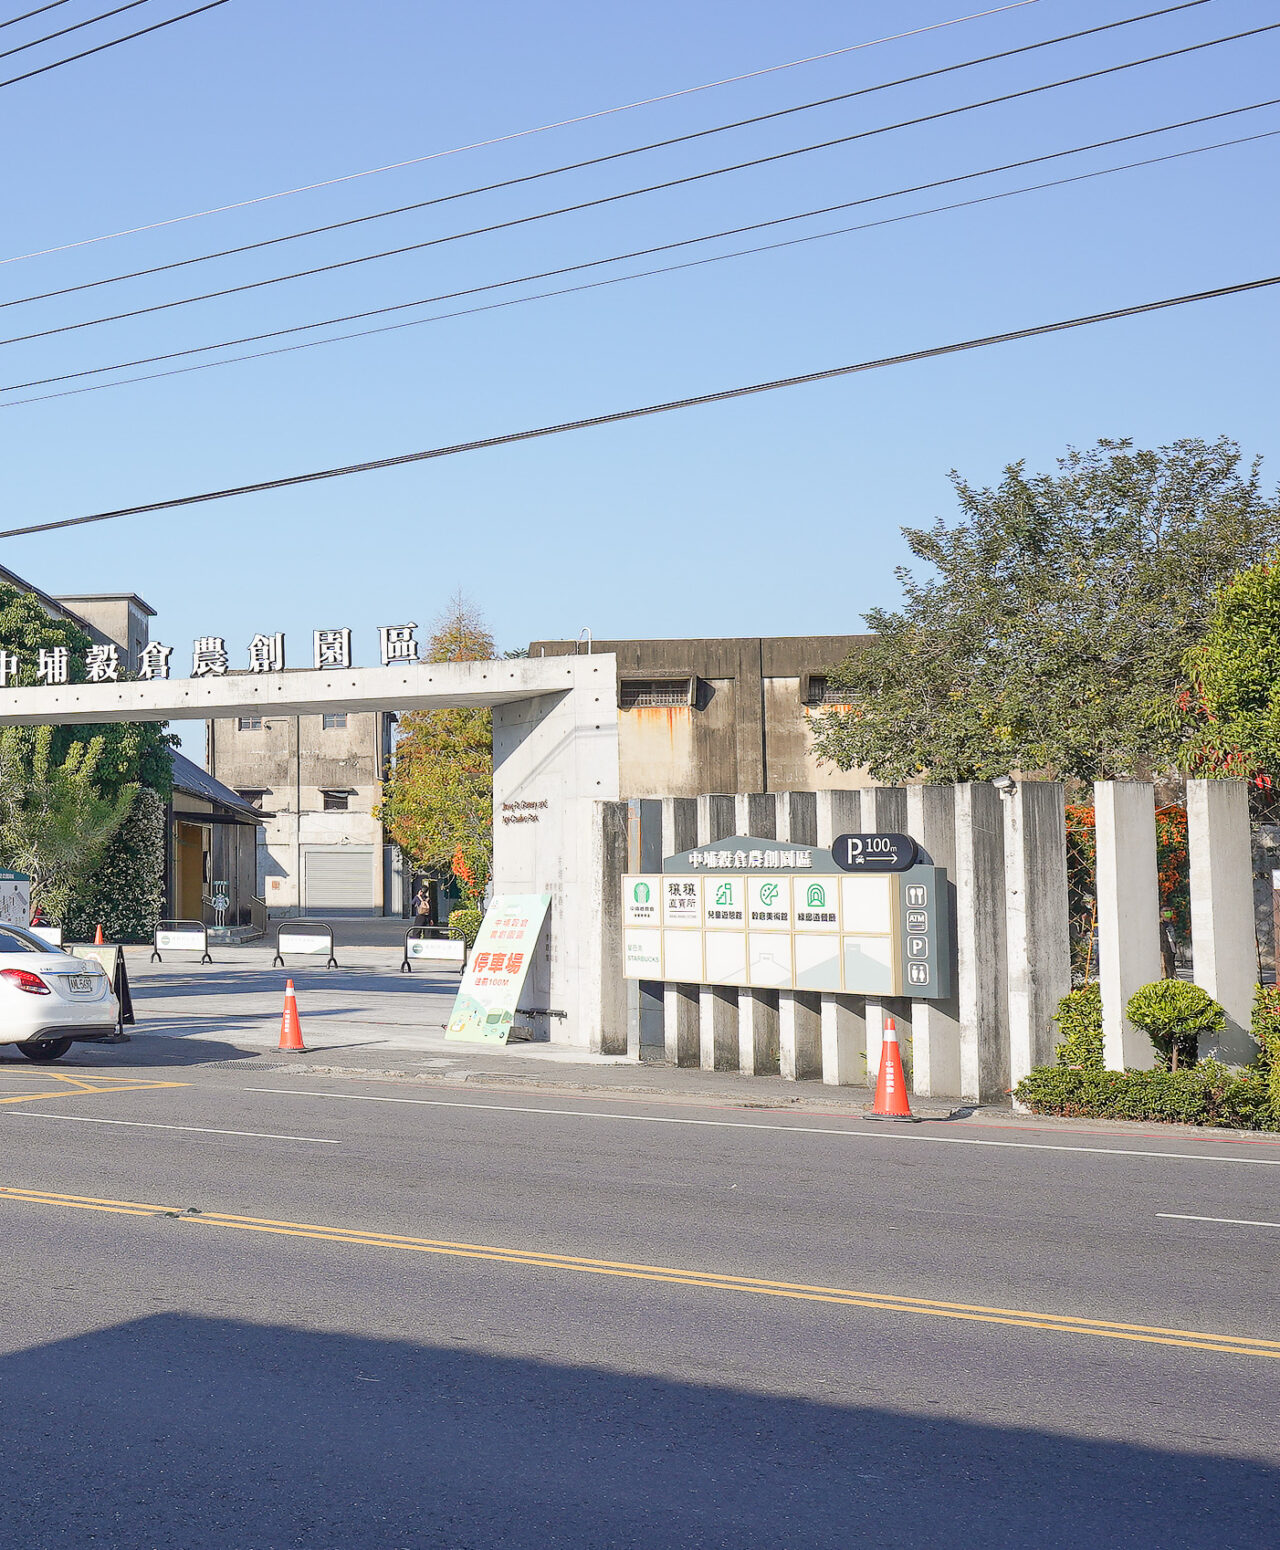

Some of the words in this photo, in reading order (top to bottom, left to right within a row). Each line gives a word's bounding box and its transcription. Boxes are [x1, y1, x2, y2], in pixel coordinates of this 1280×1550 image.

[688, 849, 813, 869] 中埔穀倉農創園區
[909, 914, 925, 923] ATM
[472, 952, 524, 975] 停車場
